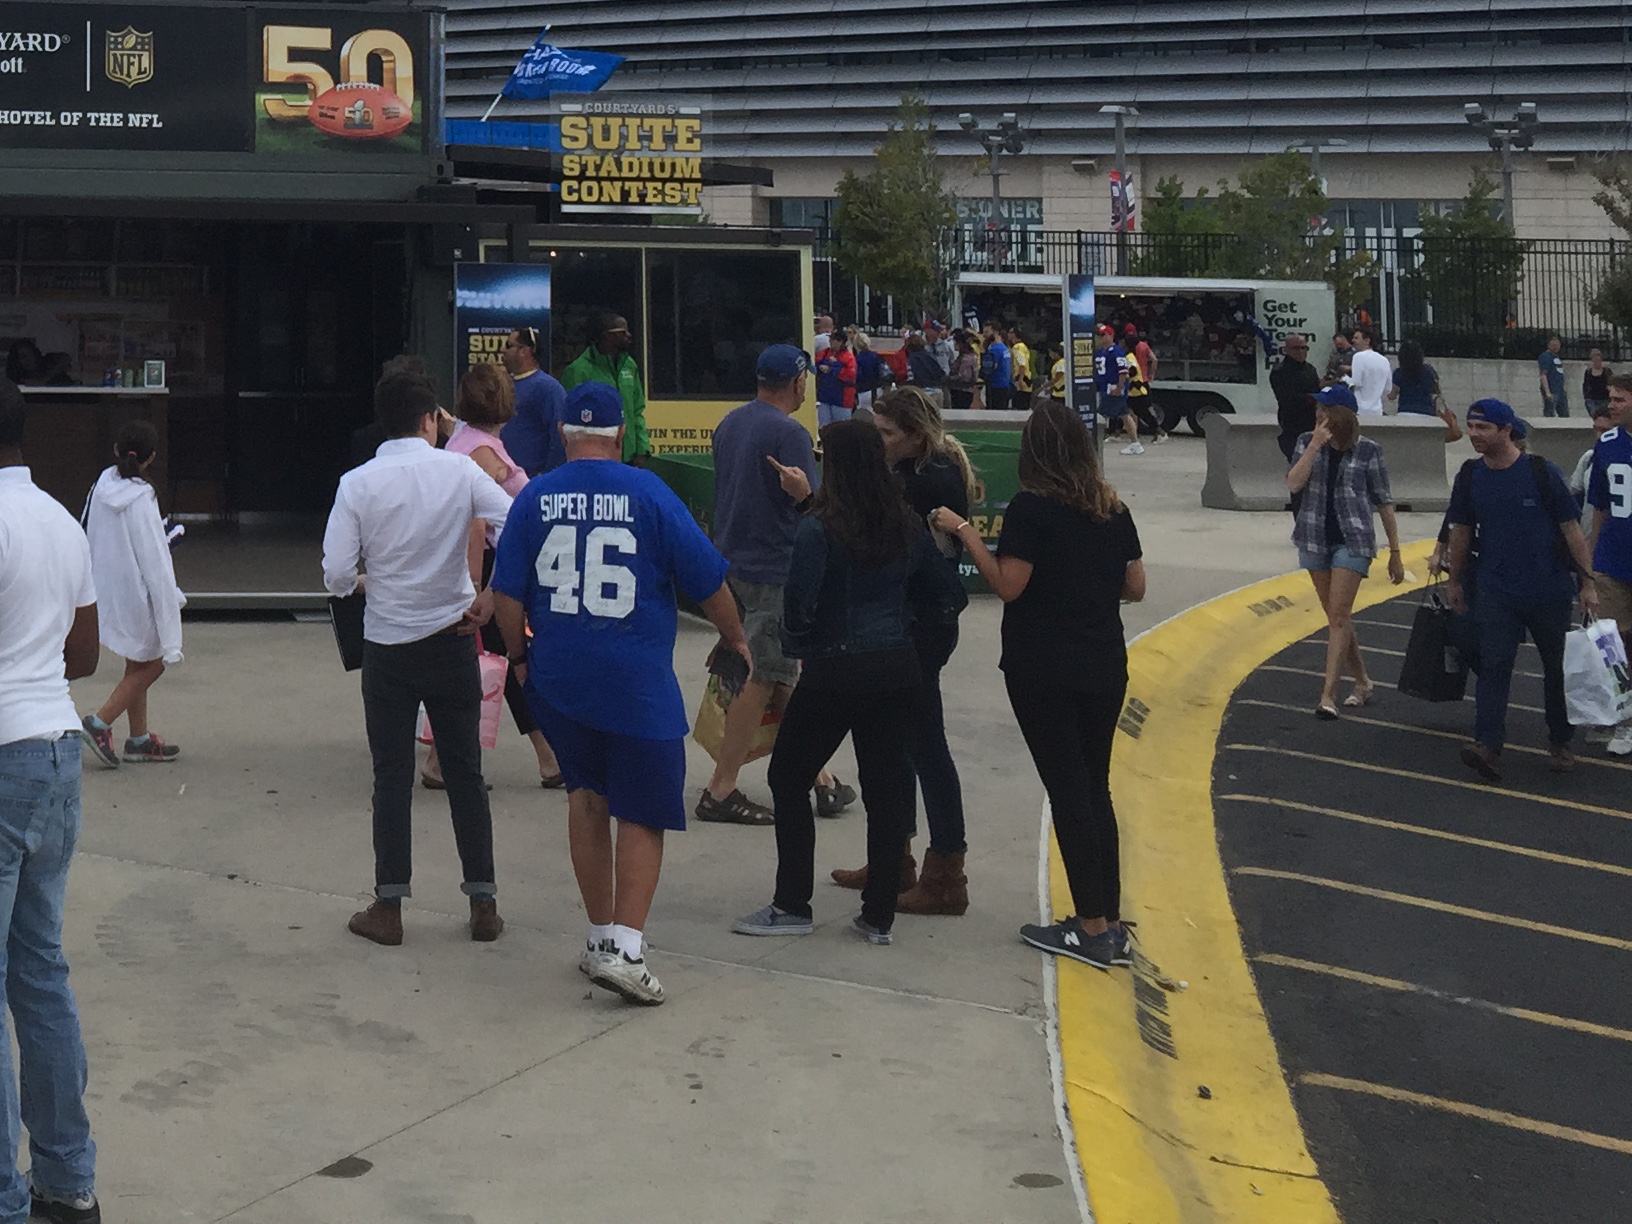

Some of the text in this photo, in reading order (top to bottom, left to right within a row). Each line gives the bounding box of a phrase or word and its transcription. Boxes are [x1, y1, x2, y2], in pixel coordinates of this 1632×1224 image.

[110, 51, 149, 79] NFL
[261, 24, 414, 123] 50
[60, 111, 83, 126] OF
[87, 112, 124, 127] THE
[128, 113, 163, 128] NFL
[560, 116, 702, 152] SUITE
[561, 154, 702, 180] STADIUM
[560, 180, 703, 205] CONTEST
[1262, 299, 1298, 314] Get
[1263, 313, 1308, 328] Your
[671, 428, 697, 440] THE
[540, 493, 635, 523] SUPER BOWL
[534, 524, 637, 619] 46
